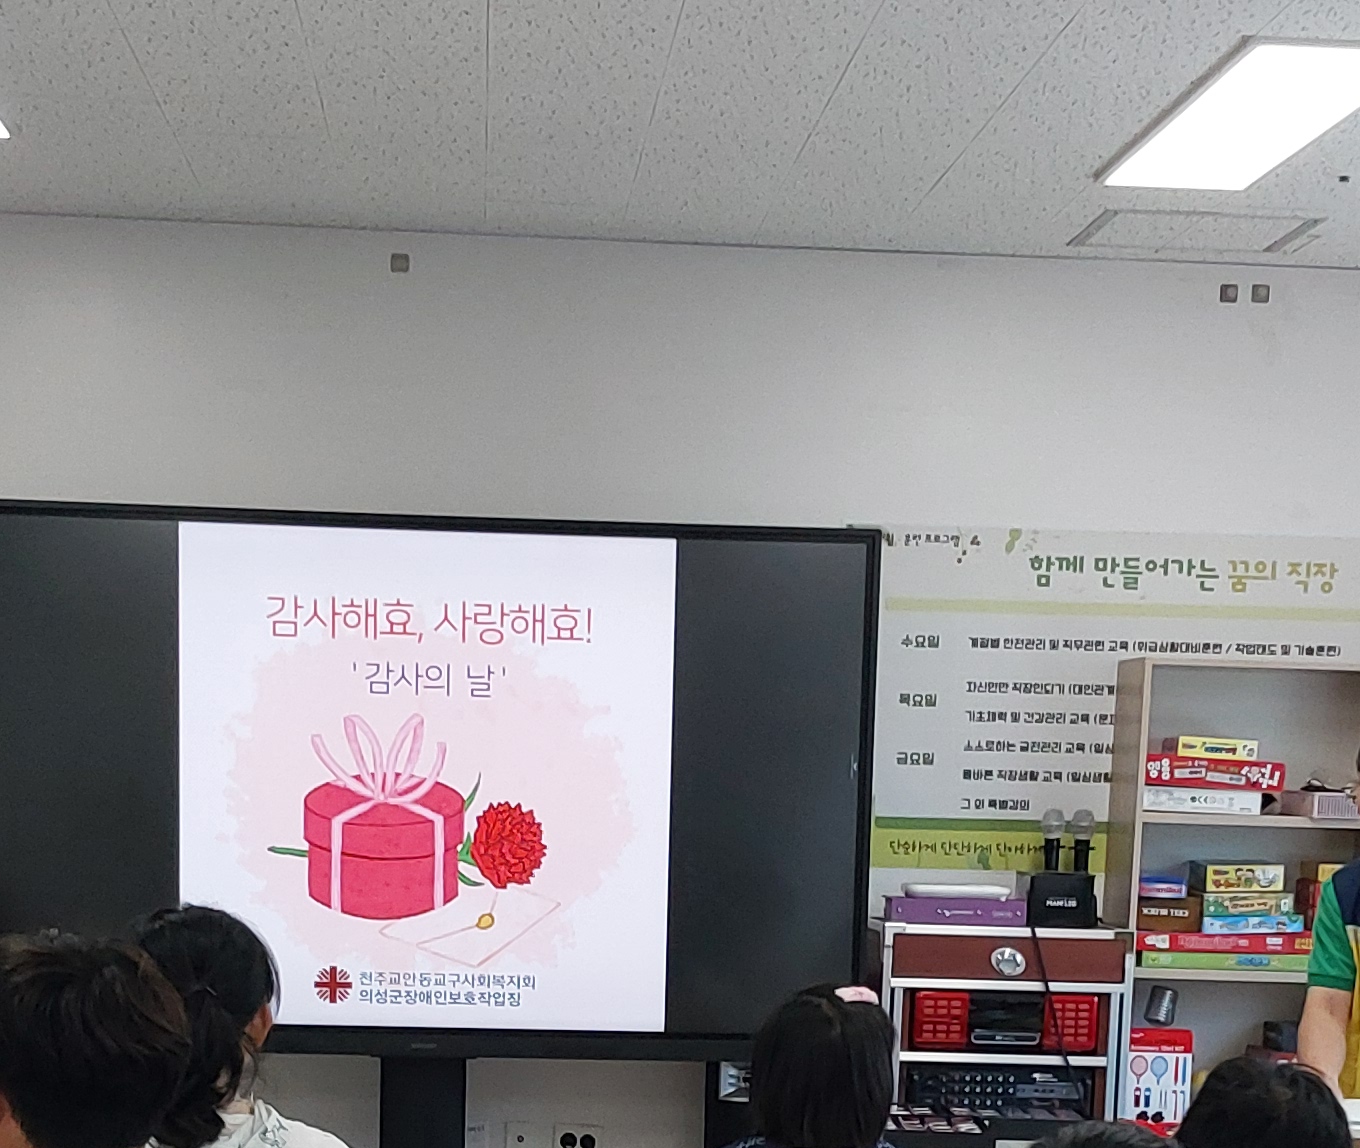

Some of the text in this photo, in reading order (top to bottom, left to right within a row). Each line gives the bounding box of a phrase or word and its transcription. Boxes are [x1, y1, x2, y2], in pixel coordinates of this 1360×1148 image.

[924, 533, 960, 548] 프로그램
[1029, 555, 1339, 594] 함께 만들어가는 꿈의 직장
[433, 600, 593, 646] 사랑해효!
[900, 634, 940, 649] 수요일
[1003, 637, 1046, 651] 안전관리
[1107, 640, 1129, 653] 교육
[1011, 682, 1066, 696] 직장인되기
[899, 693, 937, 708] 목요일
[965, 710, 1007, 724] 기초체력
[1023, 712, 1067, 725] 건강관리
[1069, 713, 1090, 726] 교육
[963, 739, 1017, 753] 스스로하는
[1019, 741, 1063, 754] 금전관리
[1065, 742, 1086, 755] 교육
[896, 752, 935, 766] 금요일
[962, 768, 994, 782] 올바른
[996, 769, 1040, 783] 직장생활
[1041, 771, 1063, 784] 교육
[960, 798, 1030, 812] 그 외 특별강의
[358, 971, 537, 991] 천주교안동교구사회복지회
